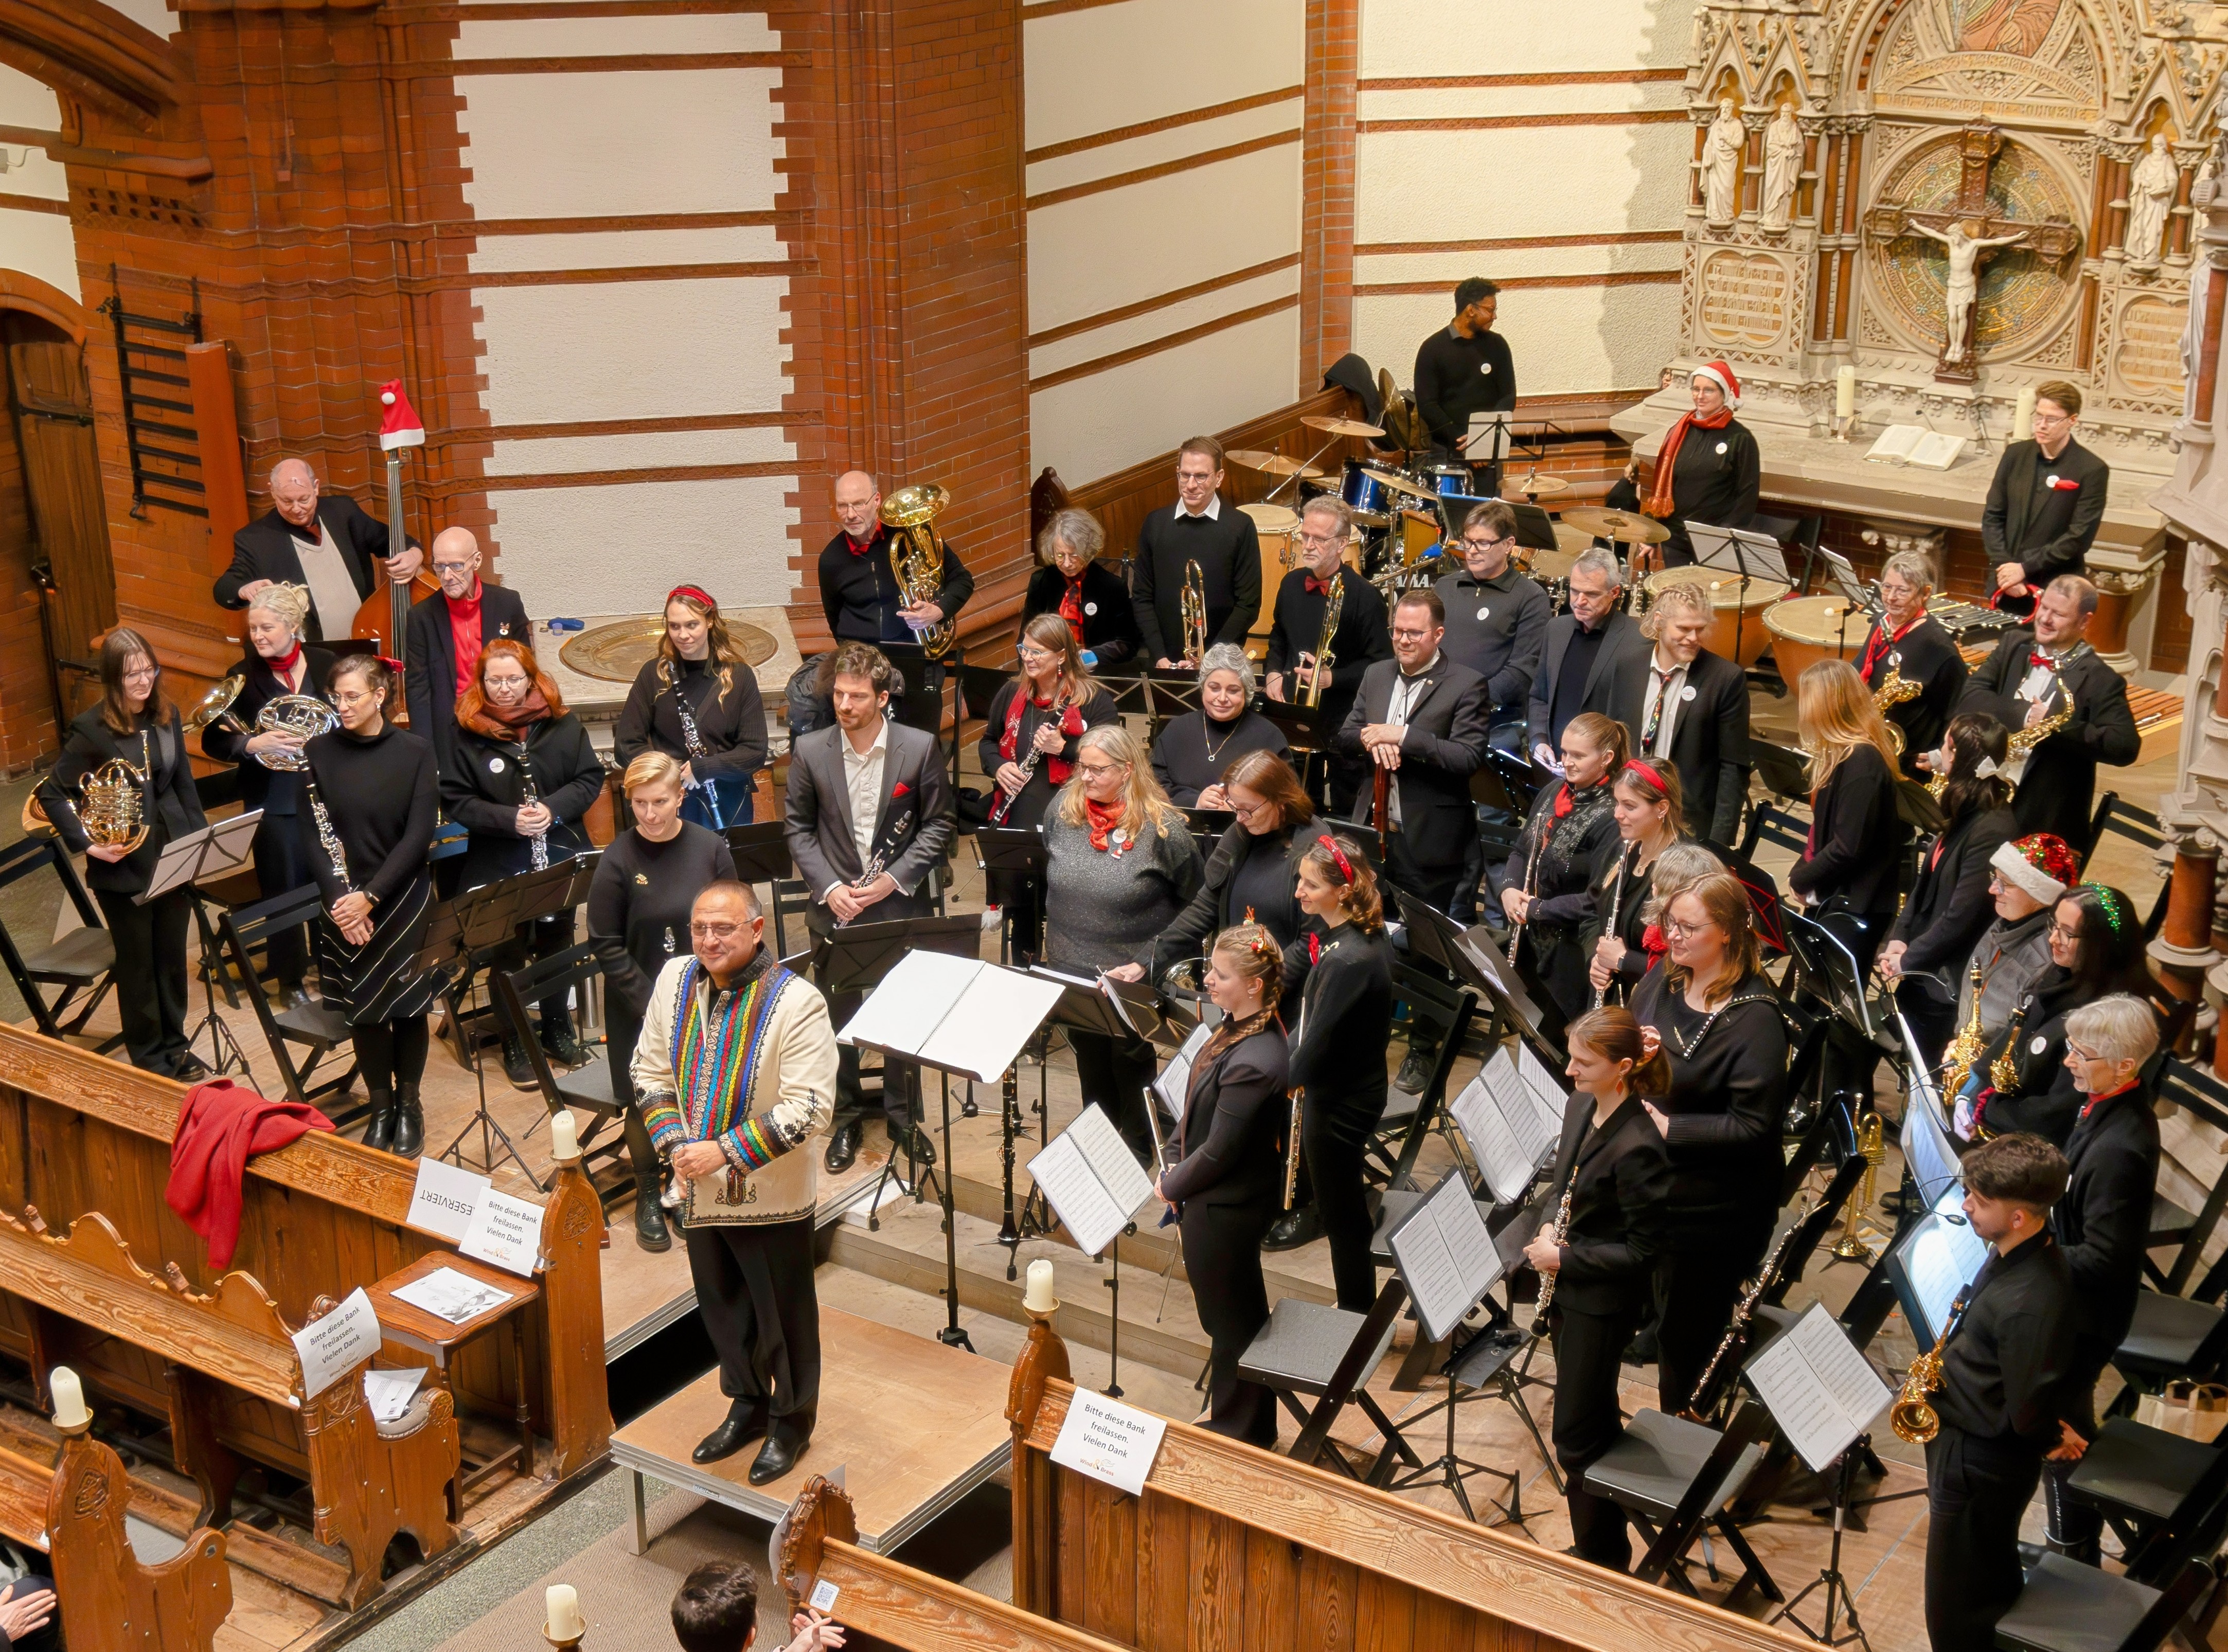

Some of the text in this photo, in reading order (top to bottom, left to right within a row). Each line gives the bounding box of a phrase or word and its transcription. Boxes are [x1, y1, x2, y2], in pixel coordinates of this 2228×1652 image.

[420, 1190, 475, 1215] ESERVIERT
[488, 1200, 538, 1224] Bitte diese Bank
[487, 1226, 523, 1246] Vielen Dank
[493, 1215, 524, 1233] freilassen.
[310, 1306, 360, 1345] Bitte diese Bank
[322, 1325, 355, 1351] freilassen.
[322, 1346, 343, 1364] Vielen
[344, 1334, 361, 1350] Dank
[1084, 1404, 1146, 1434] Bitte diese Bank
[1091, 1421, 1129, 1443] freilassen.
[1083, 1433, 1128, 1458] Vielen Dank
[1080, 1458, 1093, 1467] Wind
[1100, 1467, 1114, 1476] Brass
